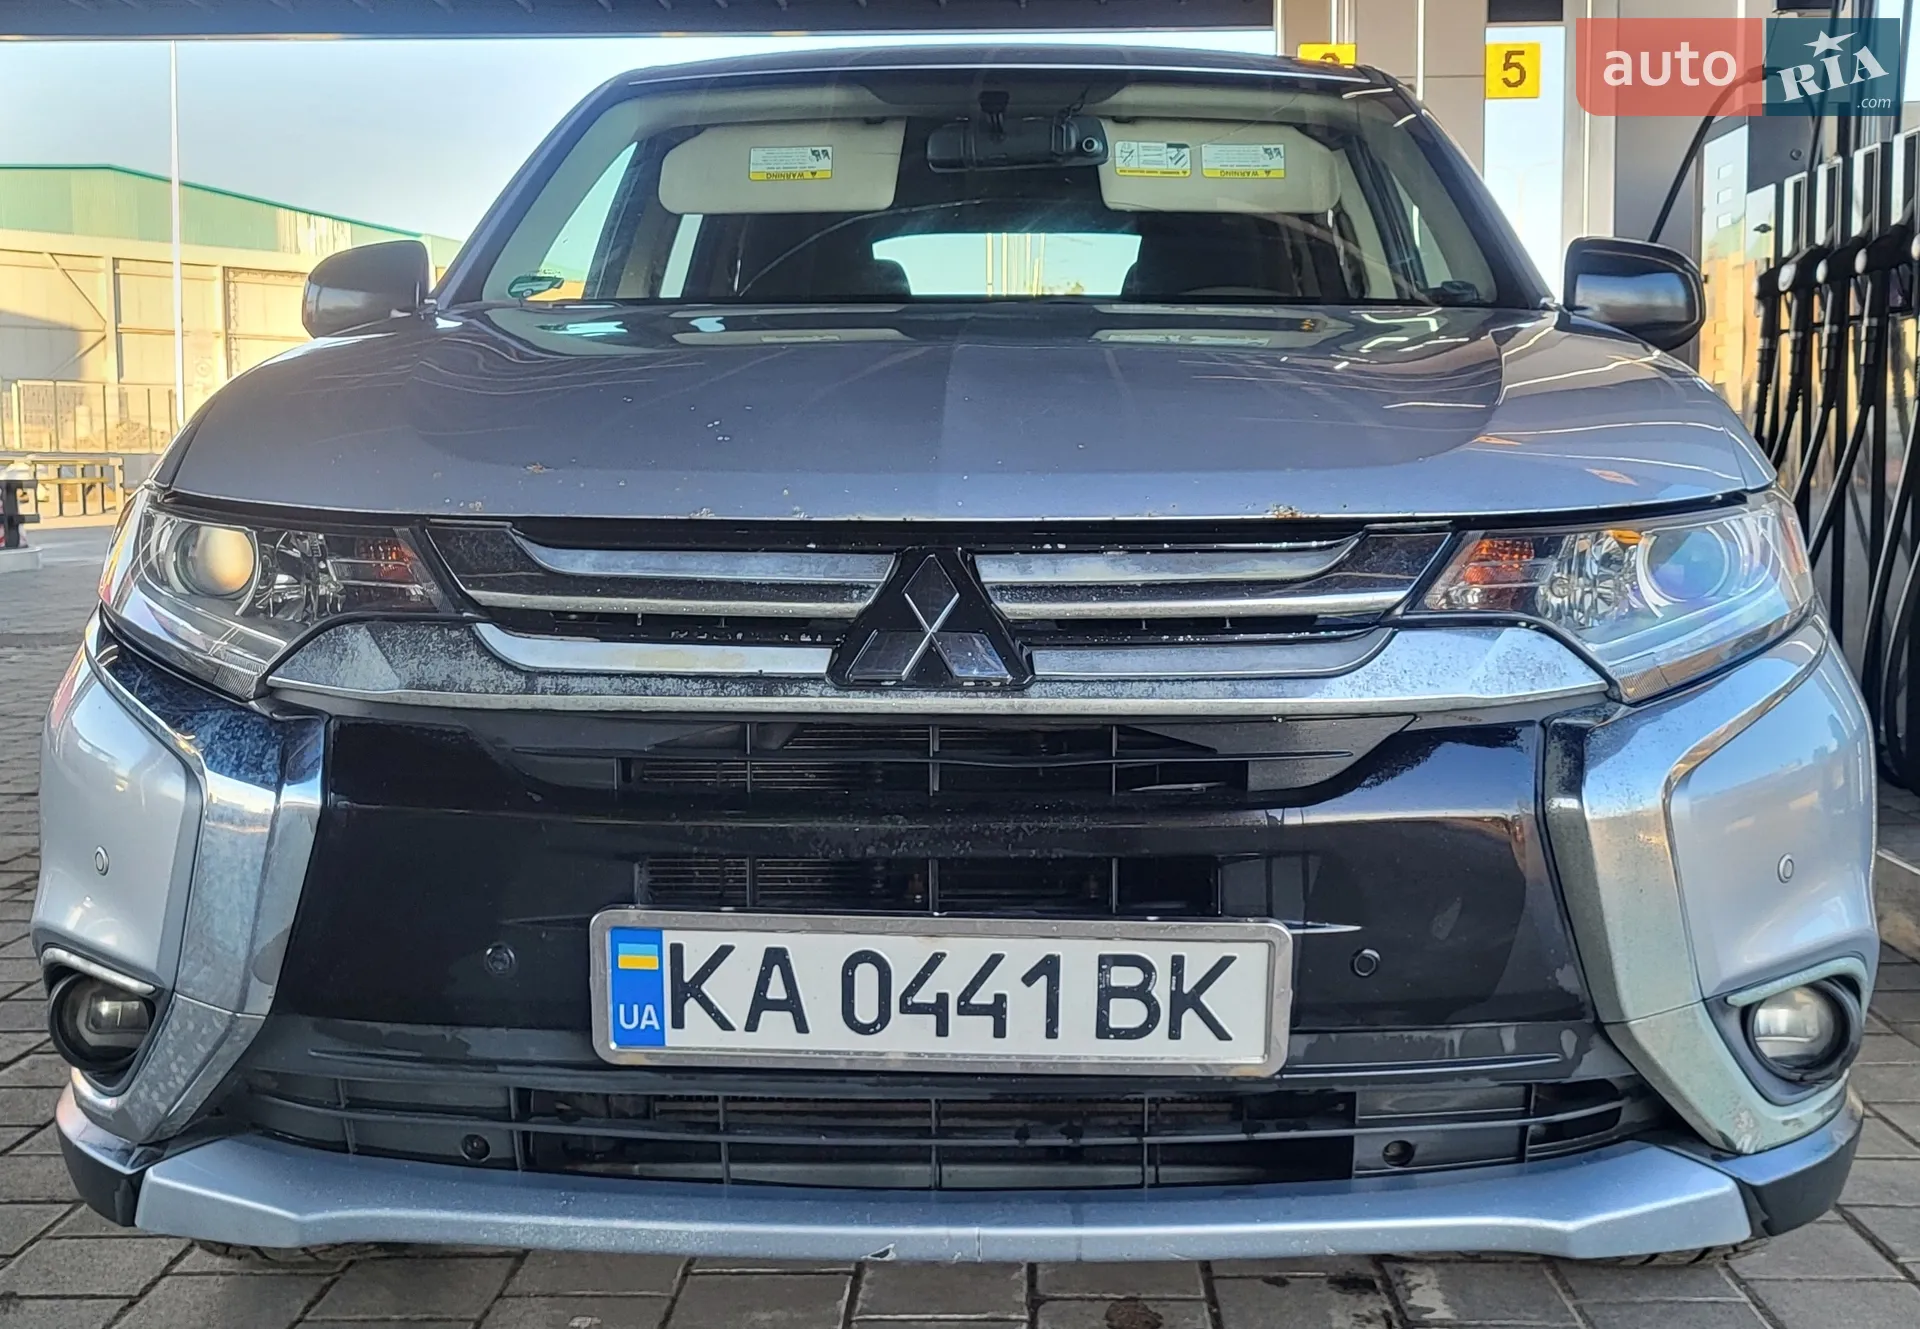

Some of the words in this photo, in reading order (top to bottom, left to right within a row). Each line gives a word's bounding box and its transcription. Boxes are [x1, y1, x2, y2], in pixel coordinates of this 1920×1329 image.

[1501, 50, 1527, 88] 5
[766, 172, 805, 180] WARNING
[668, 942, 810, 1034] KA
[840, 949, 1062, 1040] 0441
[1095, 954, 1238, 1042] BK
[618, 1003, 661, 1031] UA
